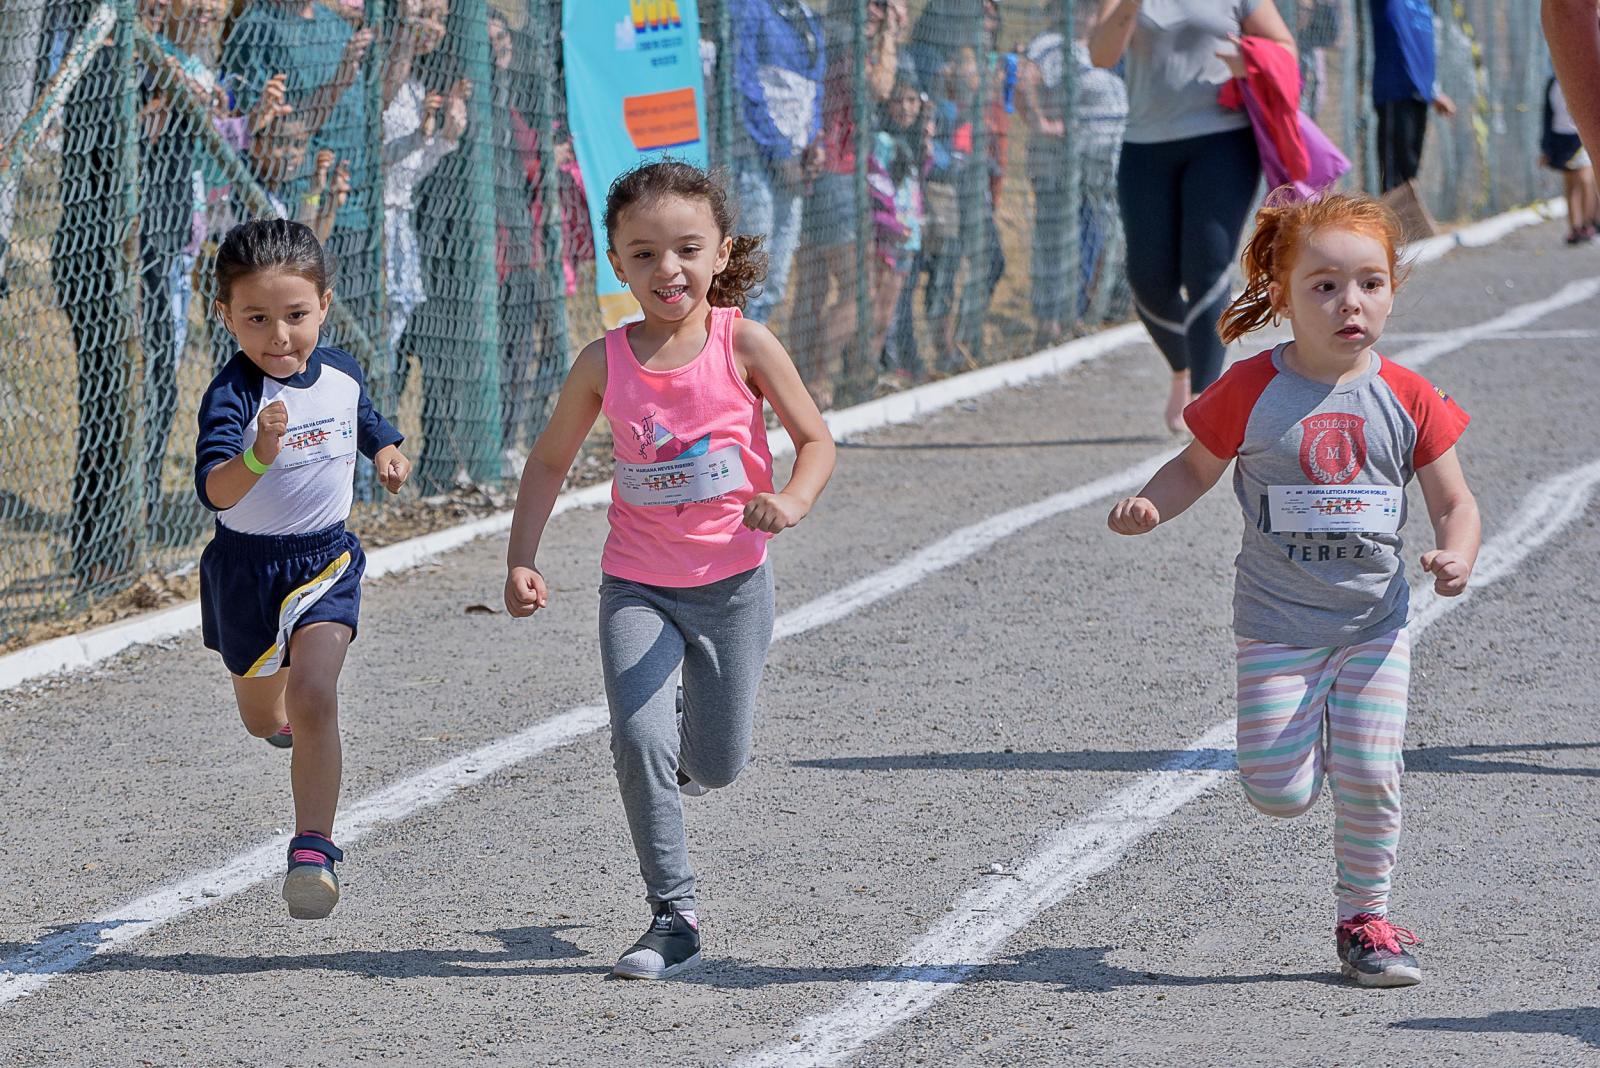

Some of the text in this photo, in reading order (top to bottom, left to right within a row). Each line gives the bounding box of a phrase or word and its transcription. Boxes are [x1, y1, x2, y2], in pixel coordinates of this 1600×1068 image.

[1309, 419, 1359, 429] COLÉGIO
[1326, 446, 1340, 460] M
[657, 465, 674, 473] NEVES
[674, 461, 695, 470] RIBEIRO
[1286, 543, 1383, 562] TEREZA
